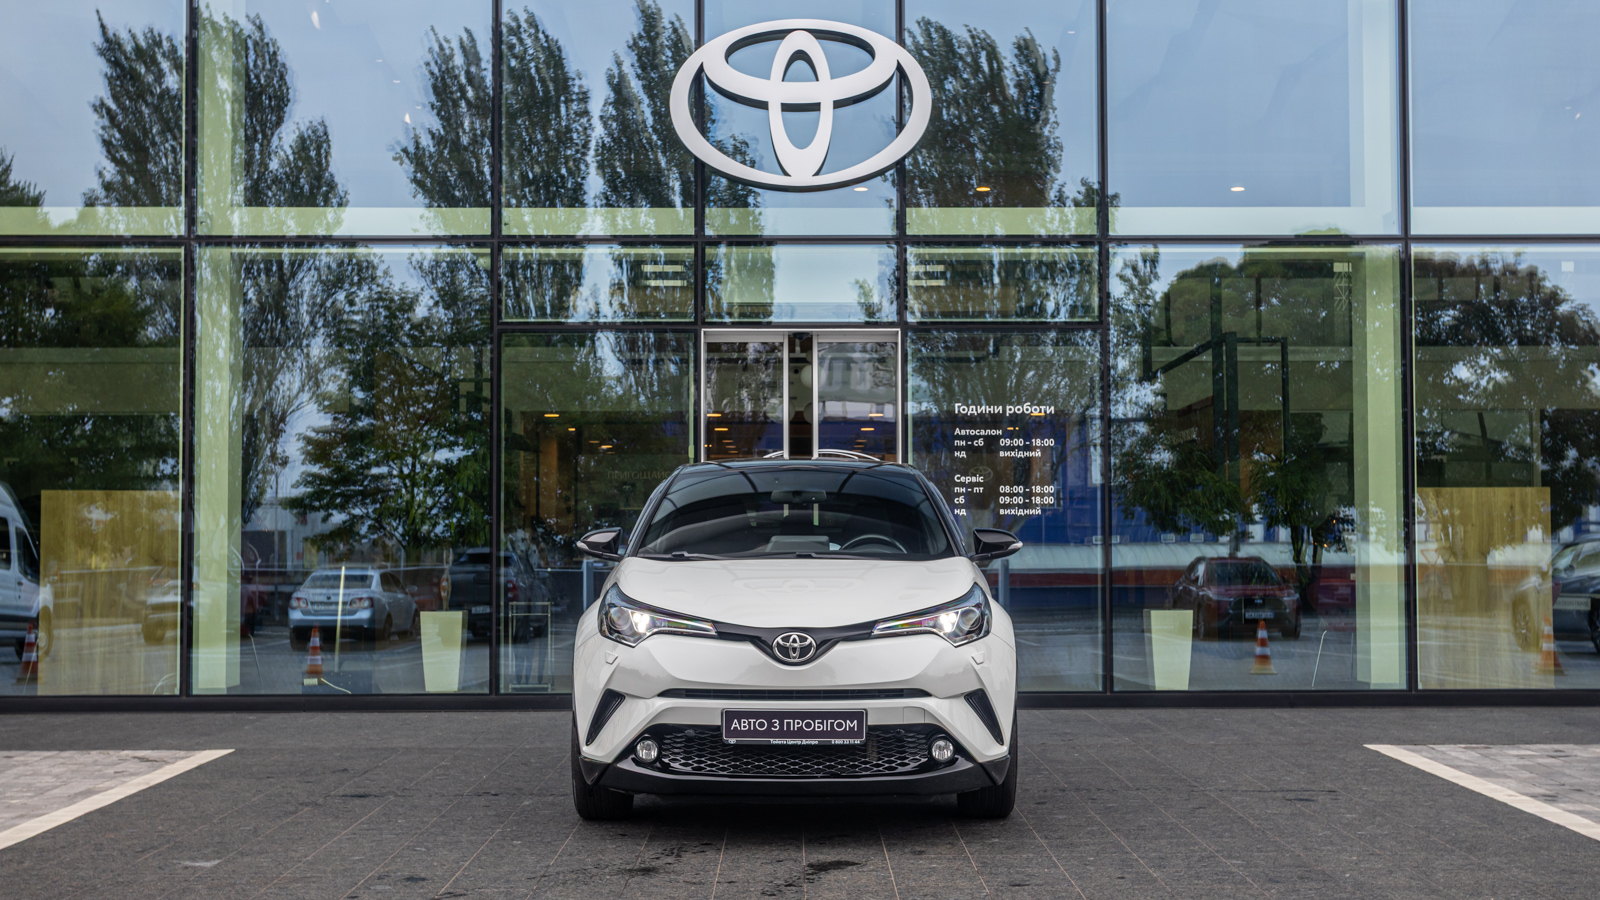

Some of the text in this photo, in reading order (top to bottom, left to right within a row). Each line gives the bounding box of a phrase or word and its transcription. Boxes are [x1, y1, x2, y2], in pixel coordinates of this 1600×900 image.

[954, 402, 1055, 417] Години роботи
[954, 427, 1003, 436] Автосалон
[973, 438, 985, 446] сб
[999, 438, 1024, 446] 09:00
[1031, 438, 1055, 446] 18:00
[954, 449, 1042, 458] нд вихідний
[954, 474, 984, 484] Сервіс
[999, 485, 1024, 493] 08:00
[1031, 485, 1055, 493] 18:00
[954, 496, 965, 504] сб
[999, 496, 1024, 504] 09:00
[1031, 496, 1055, 504] 18:00
[954, 507, 1042, 515] нд вихідний
[730, 719, 768, 731] АВТО
[783, 719, 858, 731] ПРОБІГОМ
